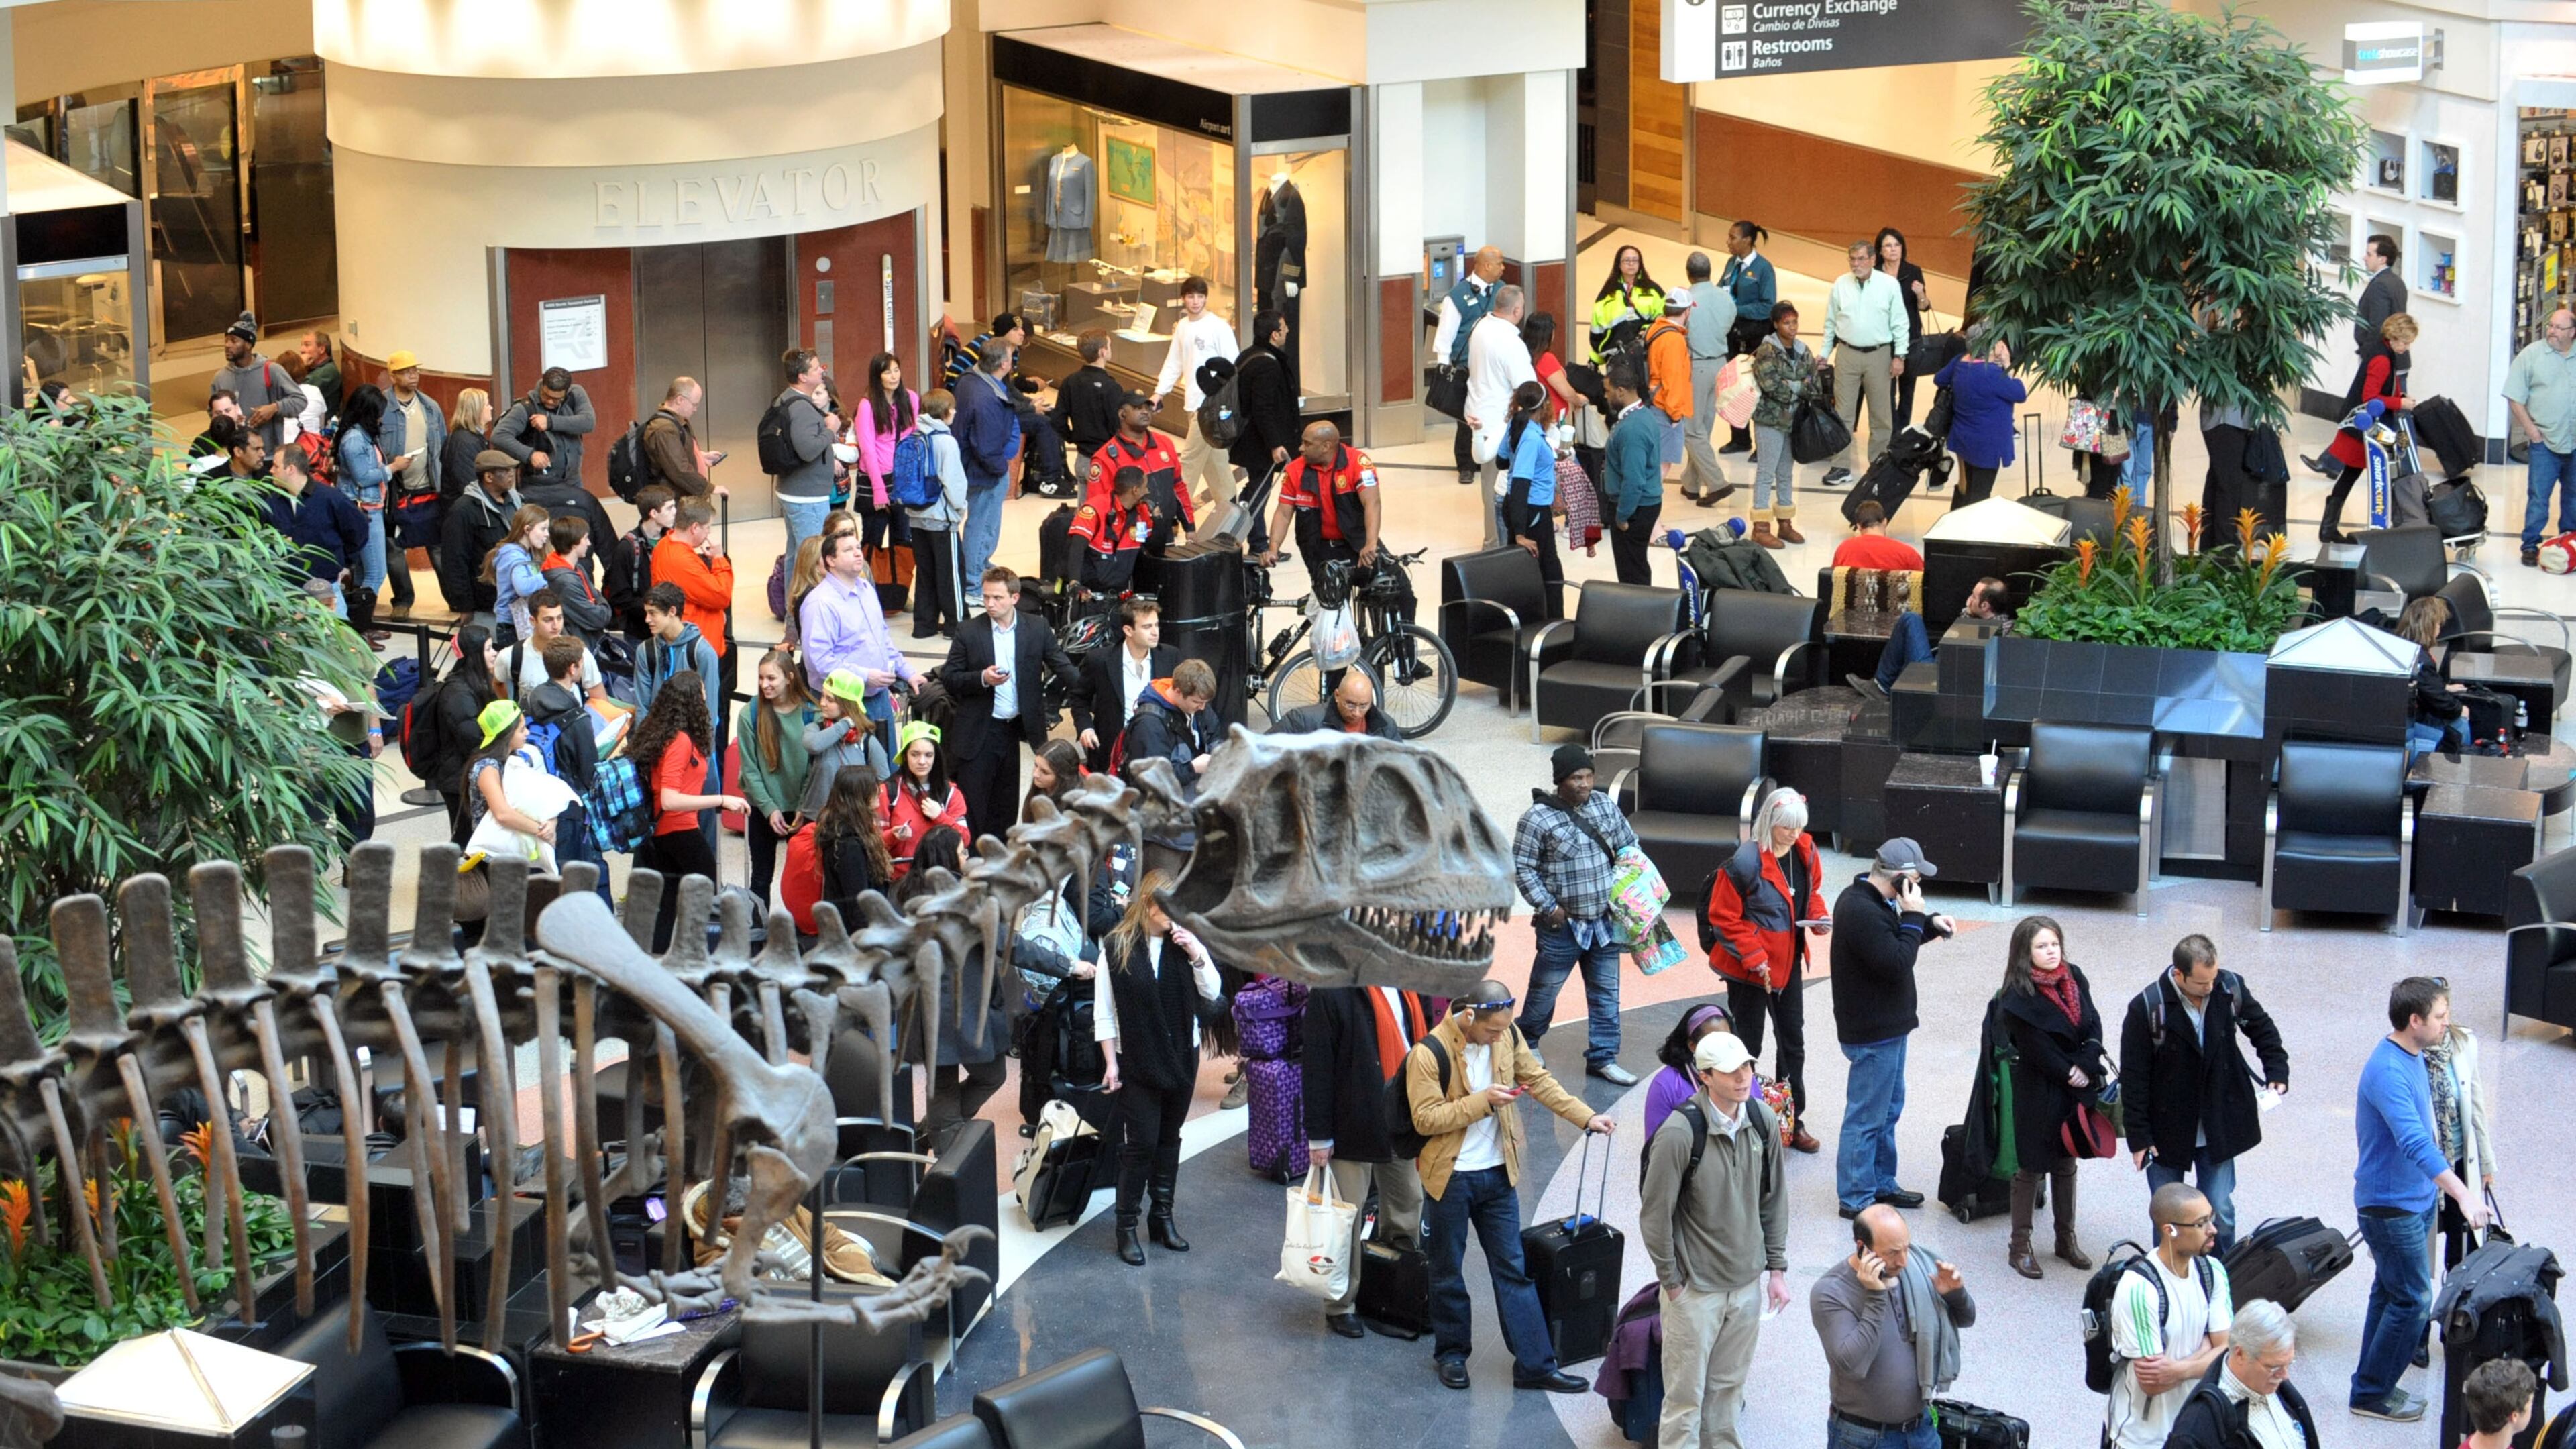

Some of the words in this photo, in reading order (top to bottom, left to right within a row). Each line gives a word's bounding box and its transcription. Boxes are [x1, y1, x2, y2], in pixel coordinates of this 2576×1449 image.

[1752, 3, 1821, 19] Currency
[1825, 0, 1898, 15] Exchange
[1752, 21, 1790, 32] Cambio
[1792, 19, 1805, 30] de
[1807, 17, 1840, 29] Divisas
[1752, 38, 1833, 55] Restrooms
[1752, 56, 1782, 68] Baños
[592, 158, 883, 228] ELEVATOR
